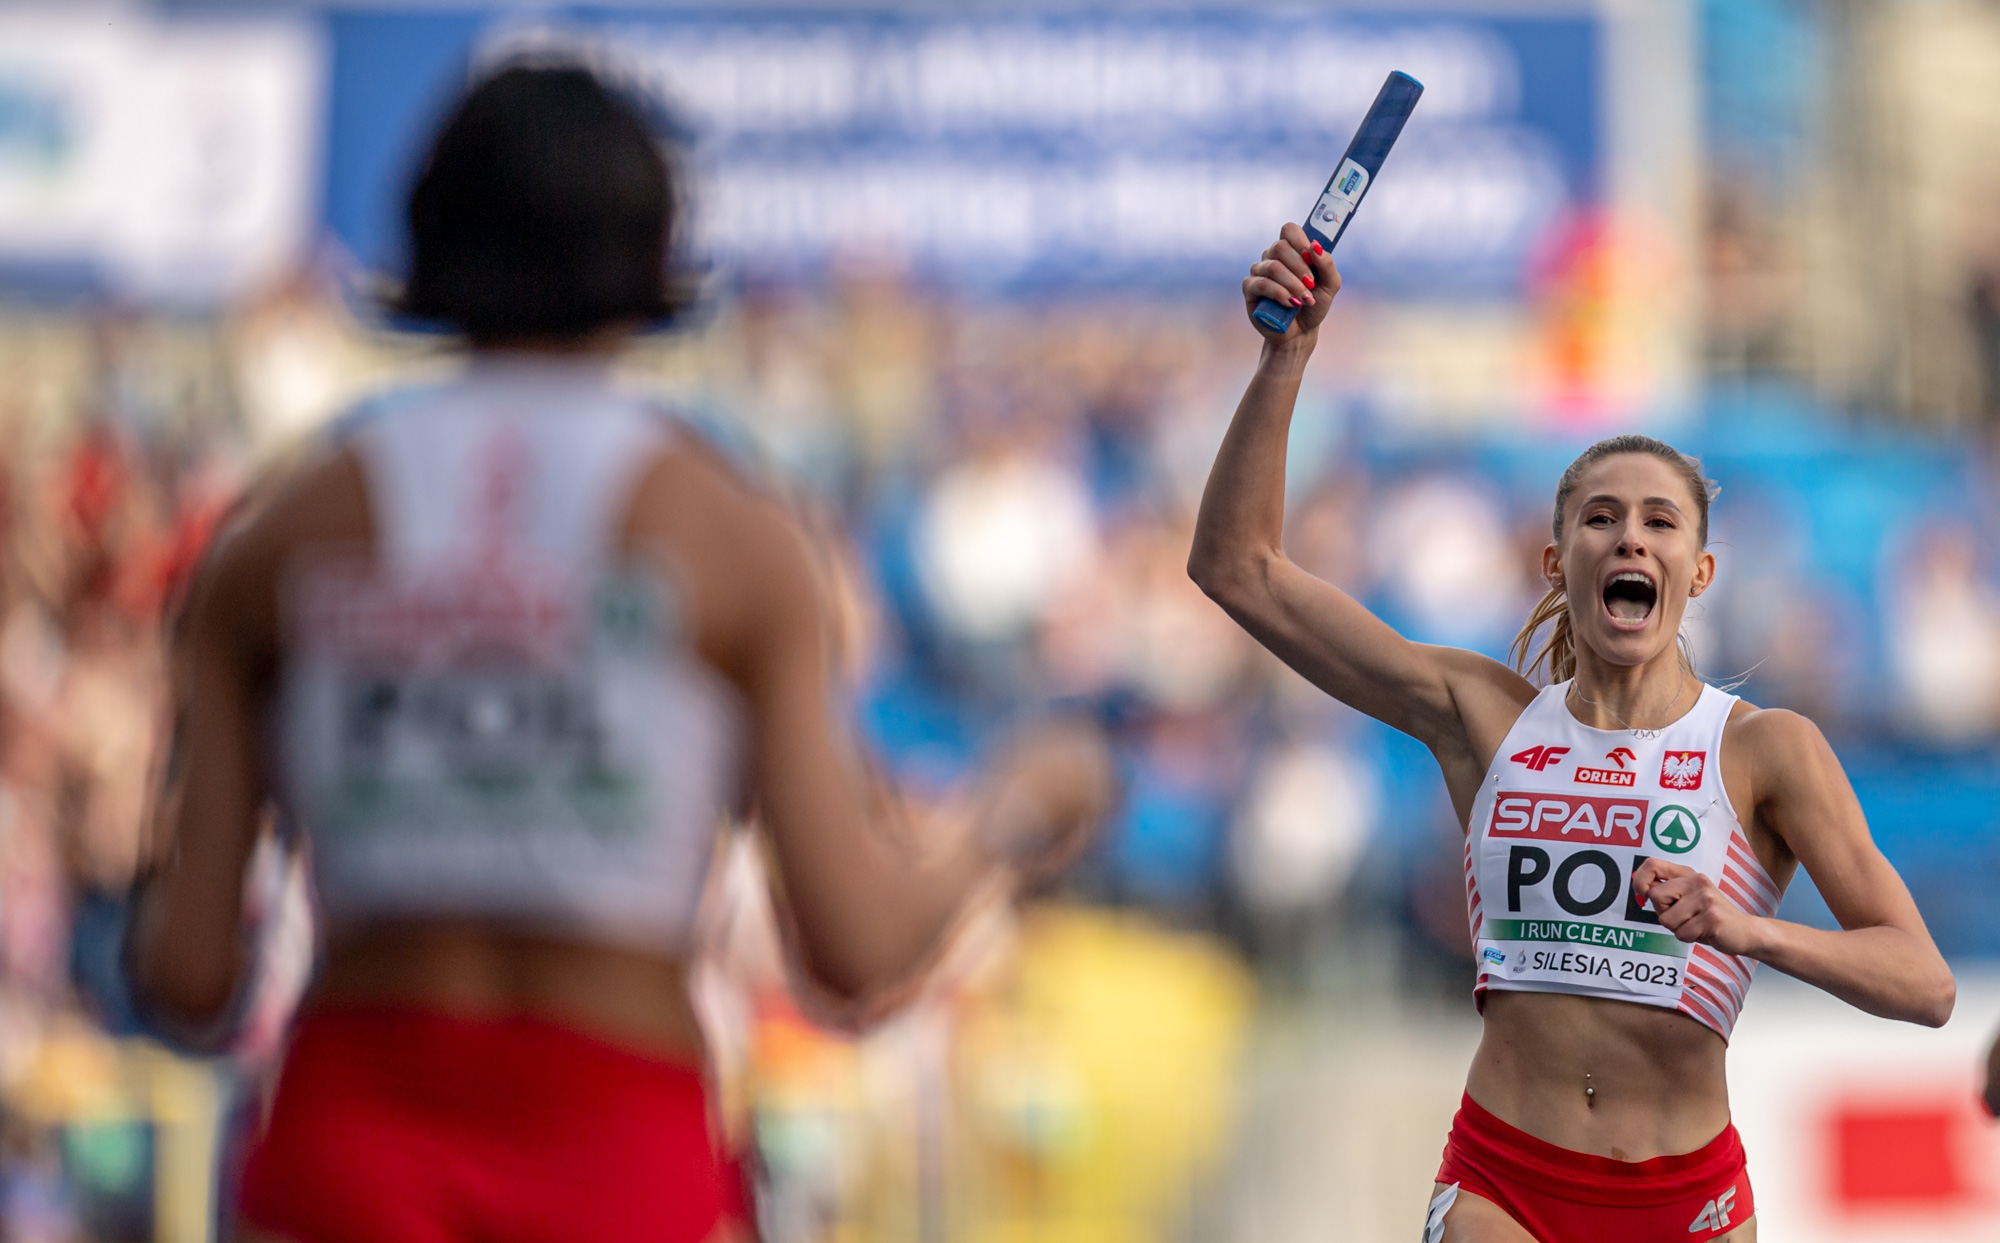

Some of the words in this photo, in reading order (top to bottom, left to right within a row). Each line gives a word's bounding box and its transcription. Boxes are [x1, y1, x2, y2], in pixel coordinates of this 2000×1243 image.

[1510, 744, 1572, 772] 4F
[1577, 769, 1633, 785] ORLEN
[1495, 797, 1642, 840] SPAR
[1520, 922, 1526, 938] I
[1528, 922, 1563, 939] RUN
[1532, 951, 1613, 978] SILESIA
[1619, 961, 1679, 987] 2023
[1688, 1184, 1737, 1233] 4F
